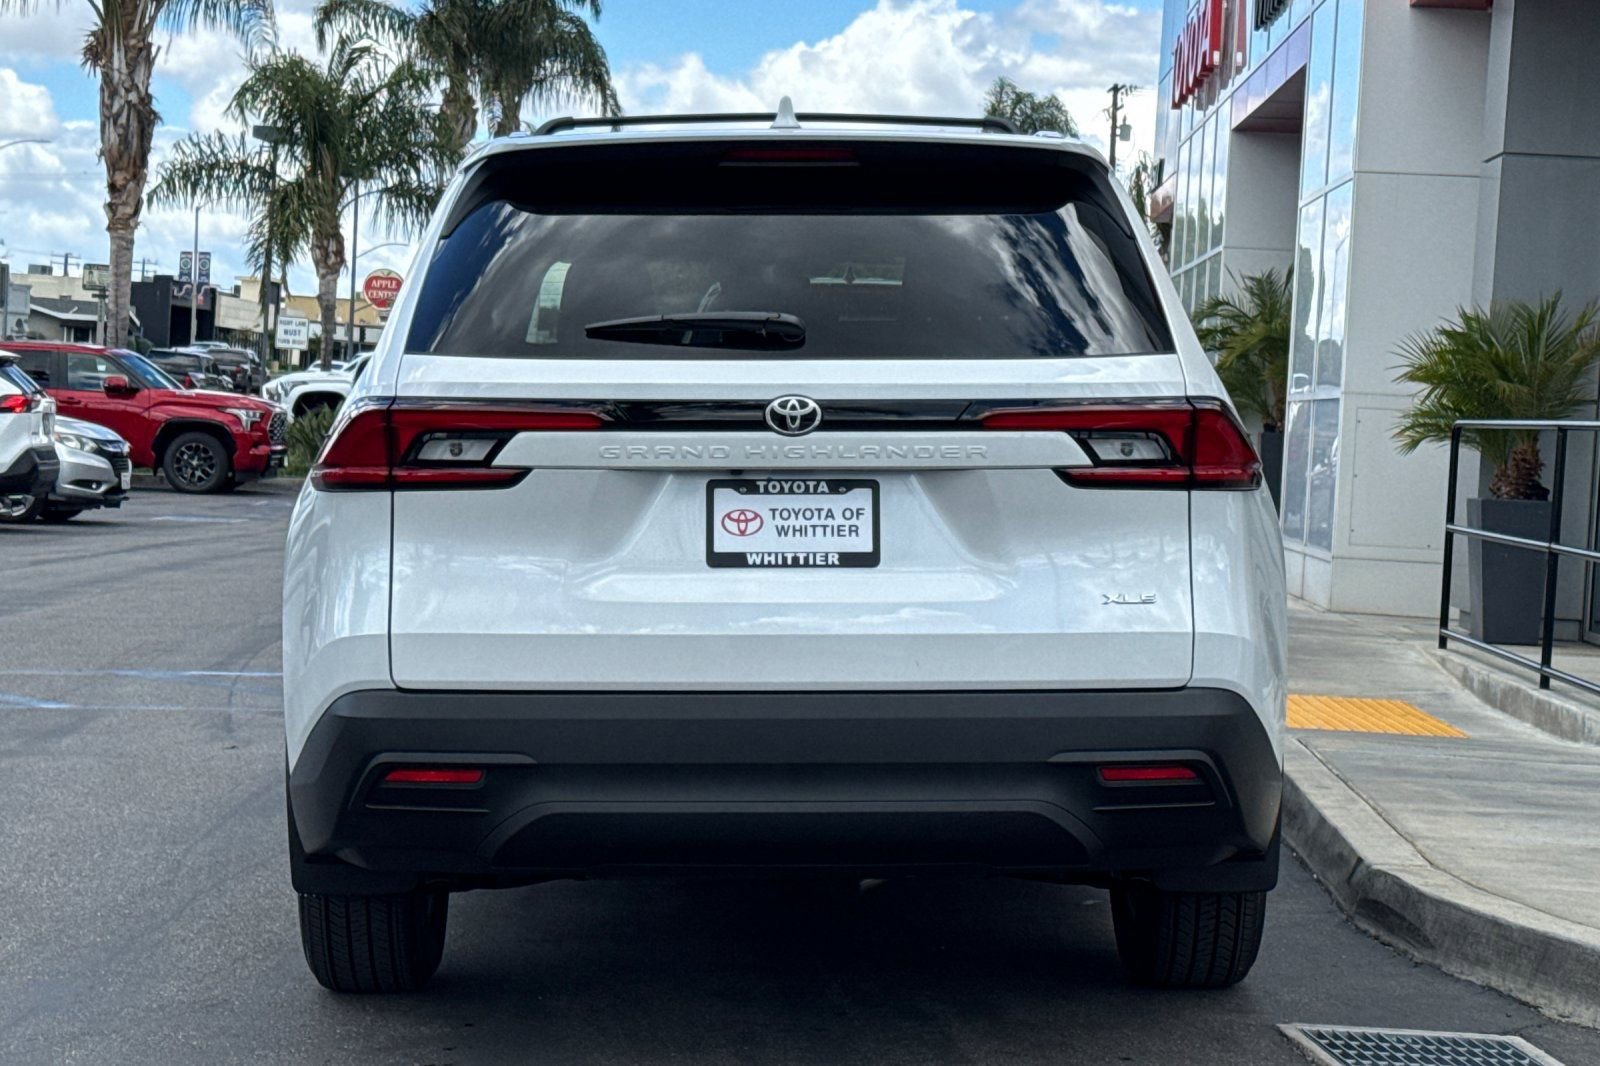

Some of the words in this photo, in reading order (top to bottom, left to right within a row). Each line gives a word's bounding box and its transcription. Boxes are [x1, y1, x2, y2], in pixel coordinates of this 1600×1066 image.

[371, 279, 397, 289] APPLE
[368, 289, 397, 299] CENTE
[599, 444, 731, 460] GRAND
[745, 444, 989, 460] HIGHLANDER
[756, 480, 830, 494] TOYOTA
[768, 507, 836, 521] TOYOTA
[842, 507, 866, 521] OF
[775, 524, 860, 538] WHITTIER
[746, 552, 840, 566] WHITTIER
[1101, 591, 1157, 605] XLE
